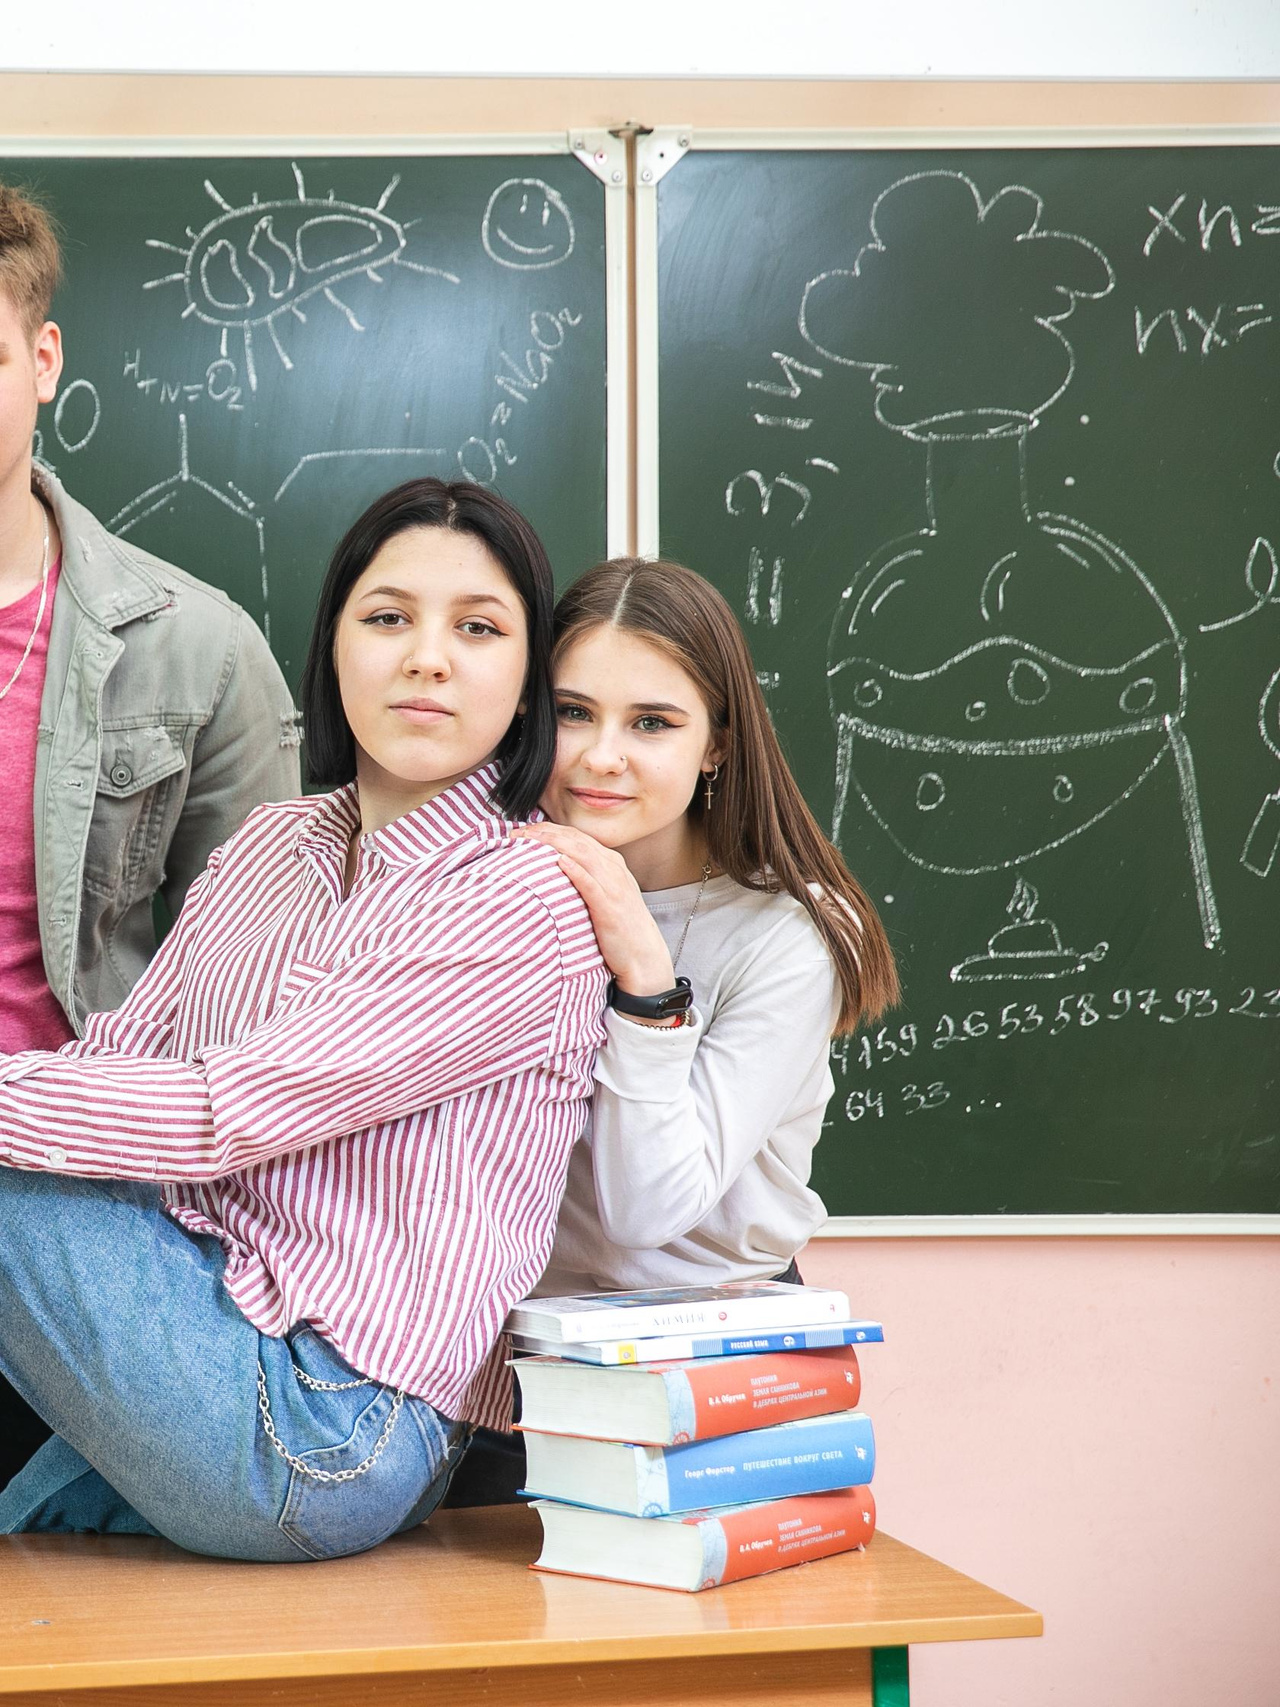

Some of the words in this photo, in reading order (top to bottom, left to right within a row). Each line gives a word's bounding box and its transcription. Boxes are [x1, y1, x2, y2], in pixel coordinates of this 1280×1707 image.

[742, 1456, 792, 1471] ПУТЕШЕСТВИЕ
[793, 1452, 820, 1464] ВОКРУГ
[821, 1450, 843, 1460] СВЕТА
